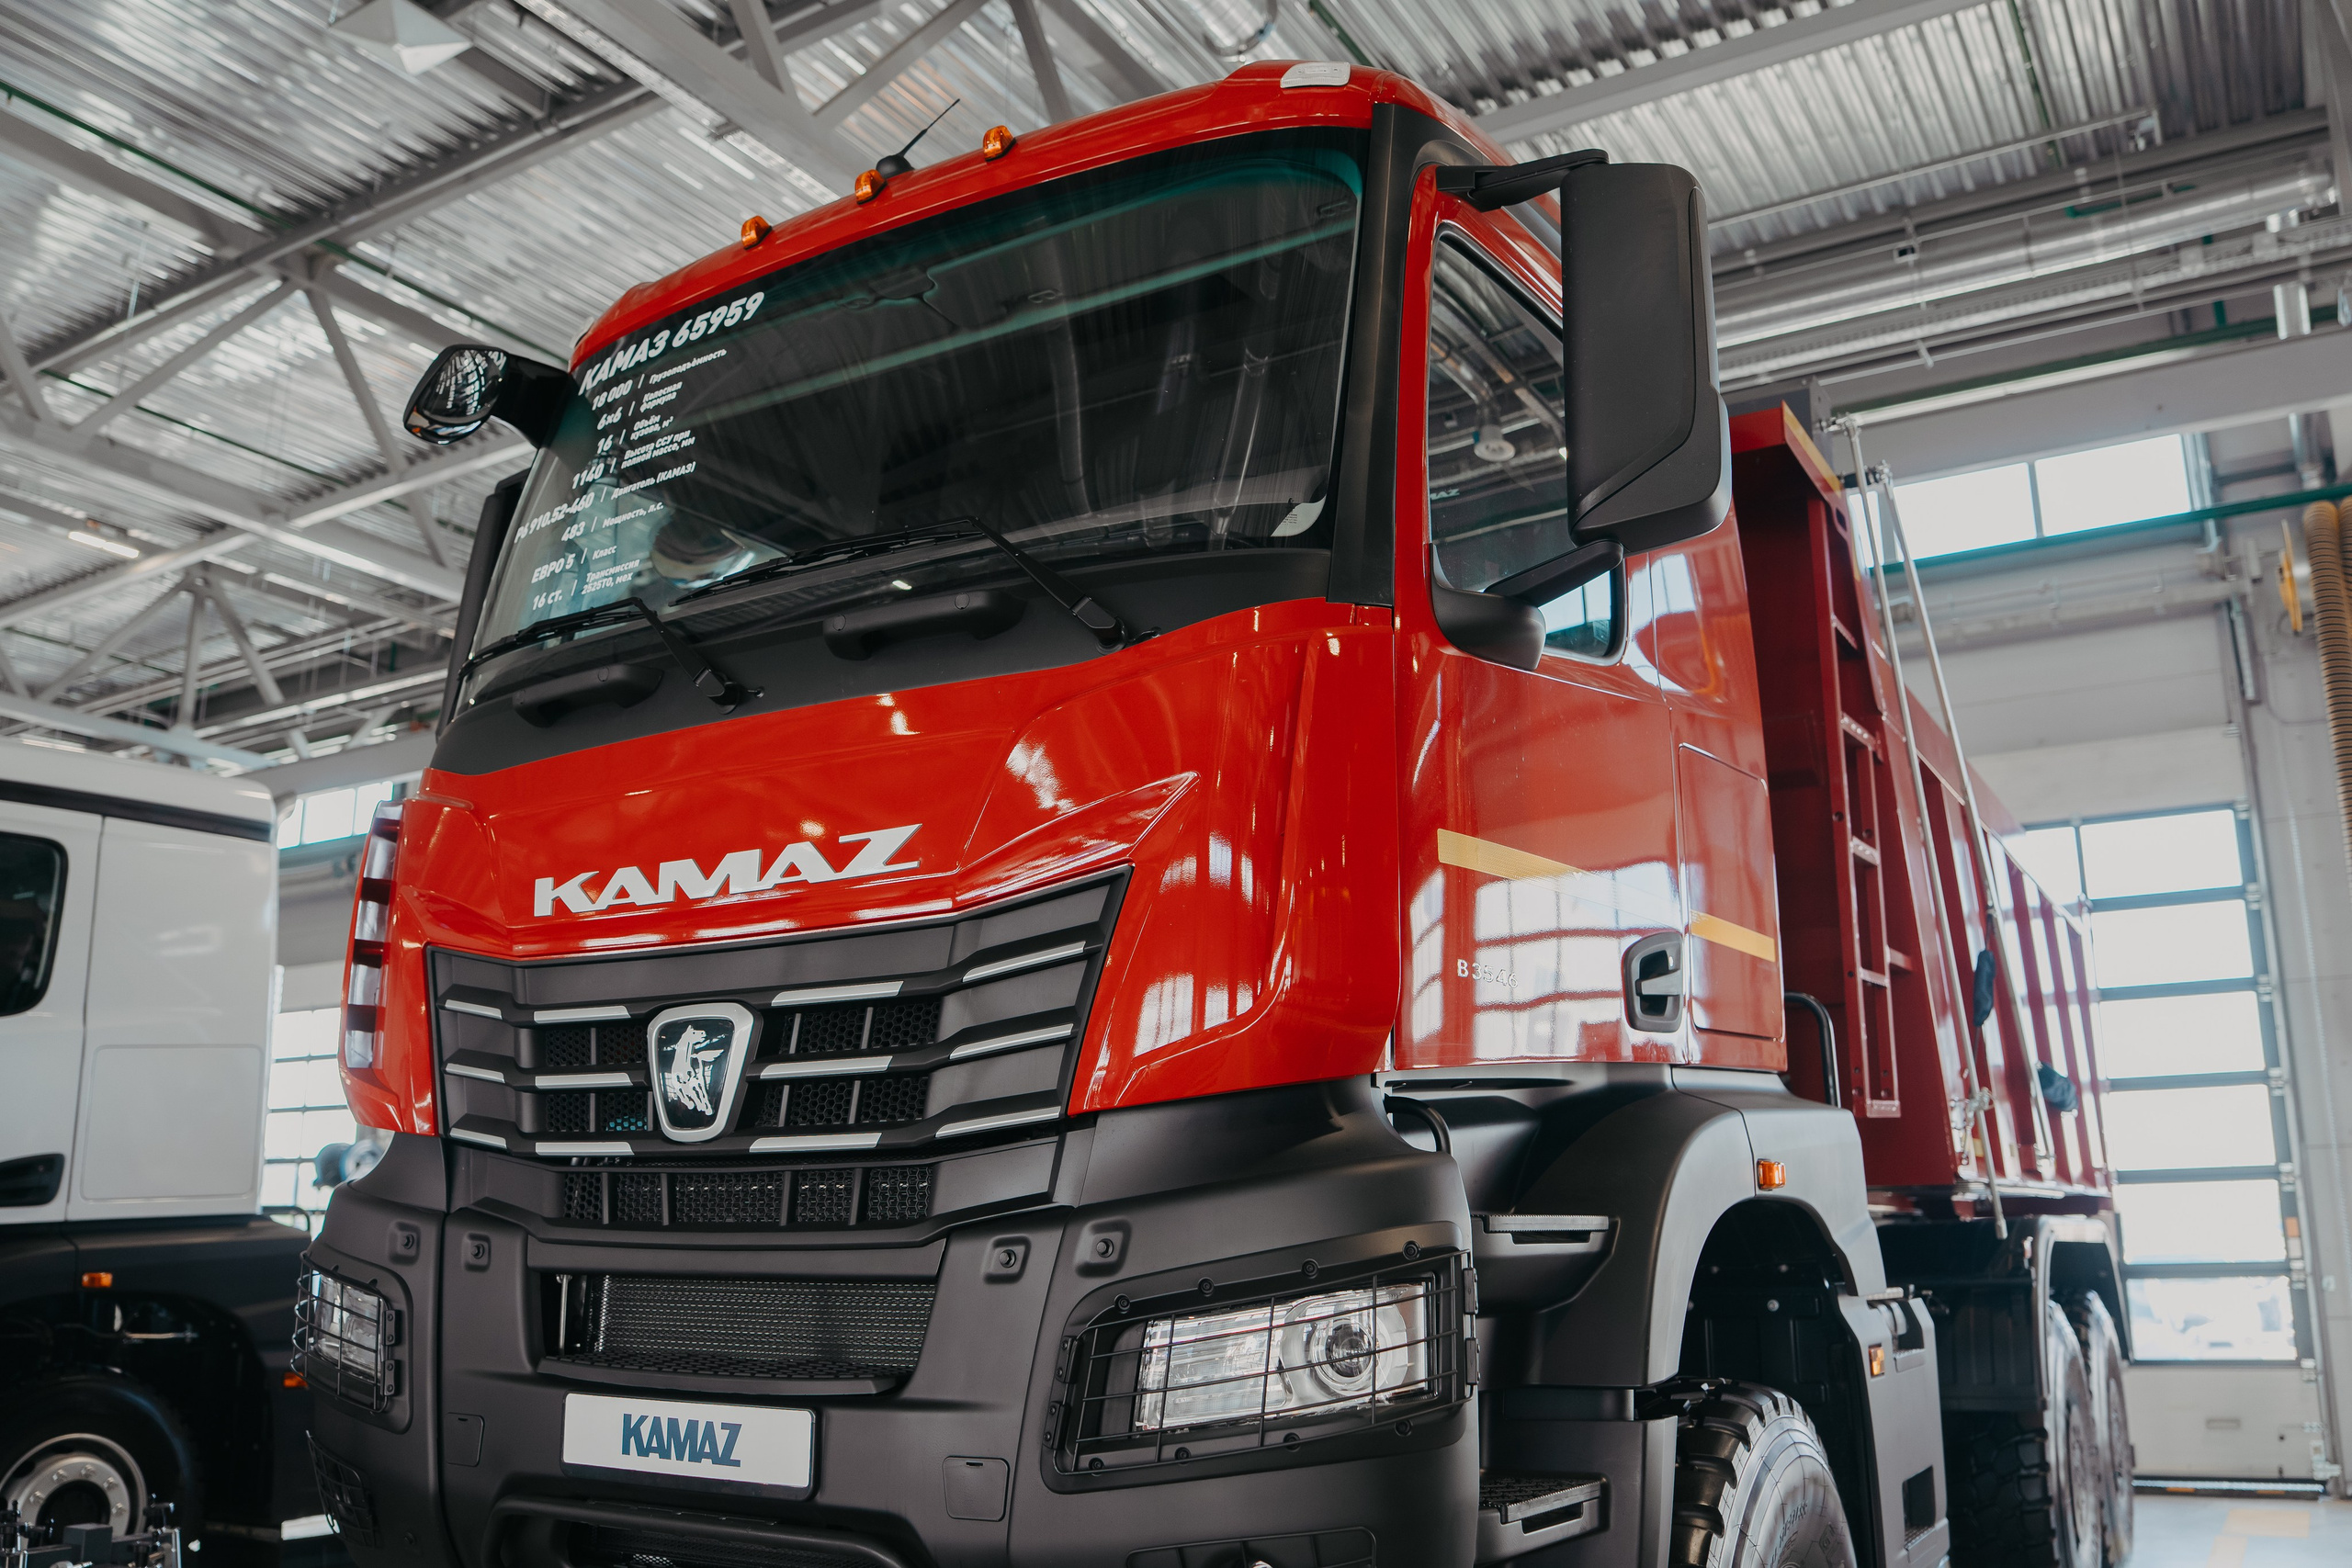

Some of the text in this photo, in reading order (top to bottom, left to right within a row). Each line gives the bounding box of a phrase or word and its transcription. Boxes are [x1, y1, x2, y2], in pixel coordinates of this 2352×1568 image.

[578, 292, 764, 396] КАМАЗ 65959
[639, 391, 677, 412] формула
[643, 381, 683, 402] Колесная
[630, 423, 661, 440] кузова,
[633, 415, 661, 431] Объём
[597, 434, 614, 454] 16
[621, 436, 695, 468] полной массе, мм
[624, 443, 655, 459] Высота
[673, 430, 691, 442] при
[571, 463, 605, 490] 1140
[611, 461, 695, 500] Двигатель (КАМАЗ)
[602, 502, 664, 528] Мощность, л.с.
[561, 521, 586, 542] 483
[593, 546, 617, 560] Класс
[531, 553, 576, 583] ЕВРО 5
[586, 559, 640, 582] Трансмиссия
[615, 572, 633, 584] мех
[532, 589, 562, 611] 16 ст.
[534, 823, 922, 917] KAMAZ
[621, 1413, 742, 1468] KAMAZ
